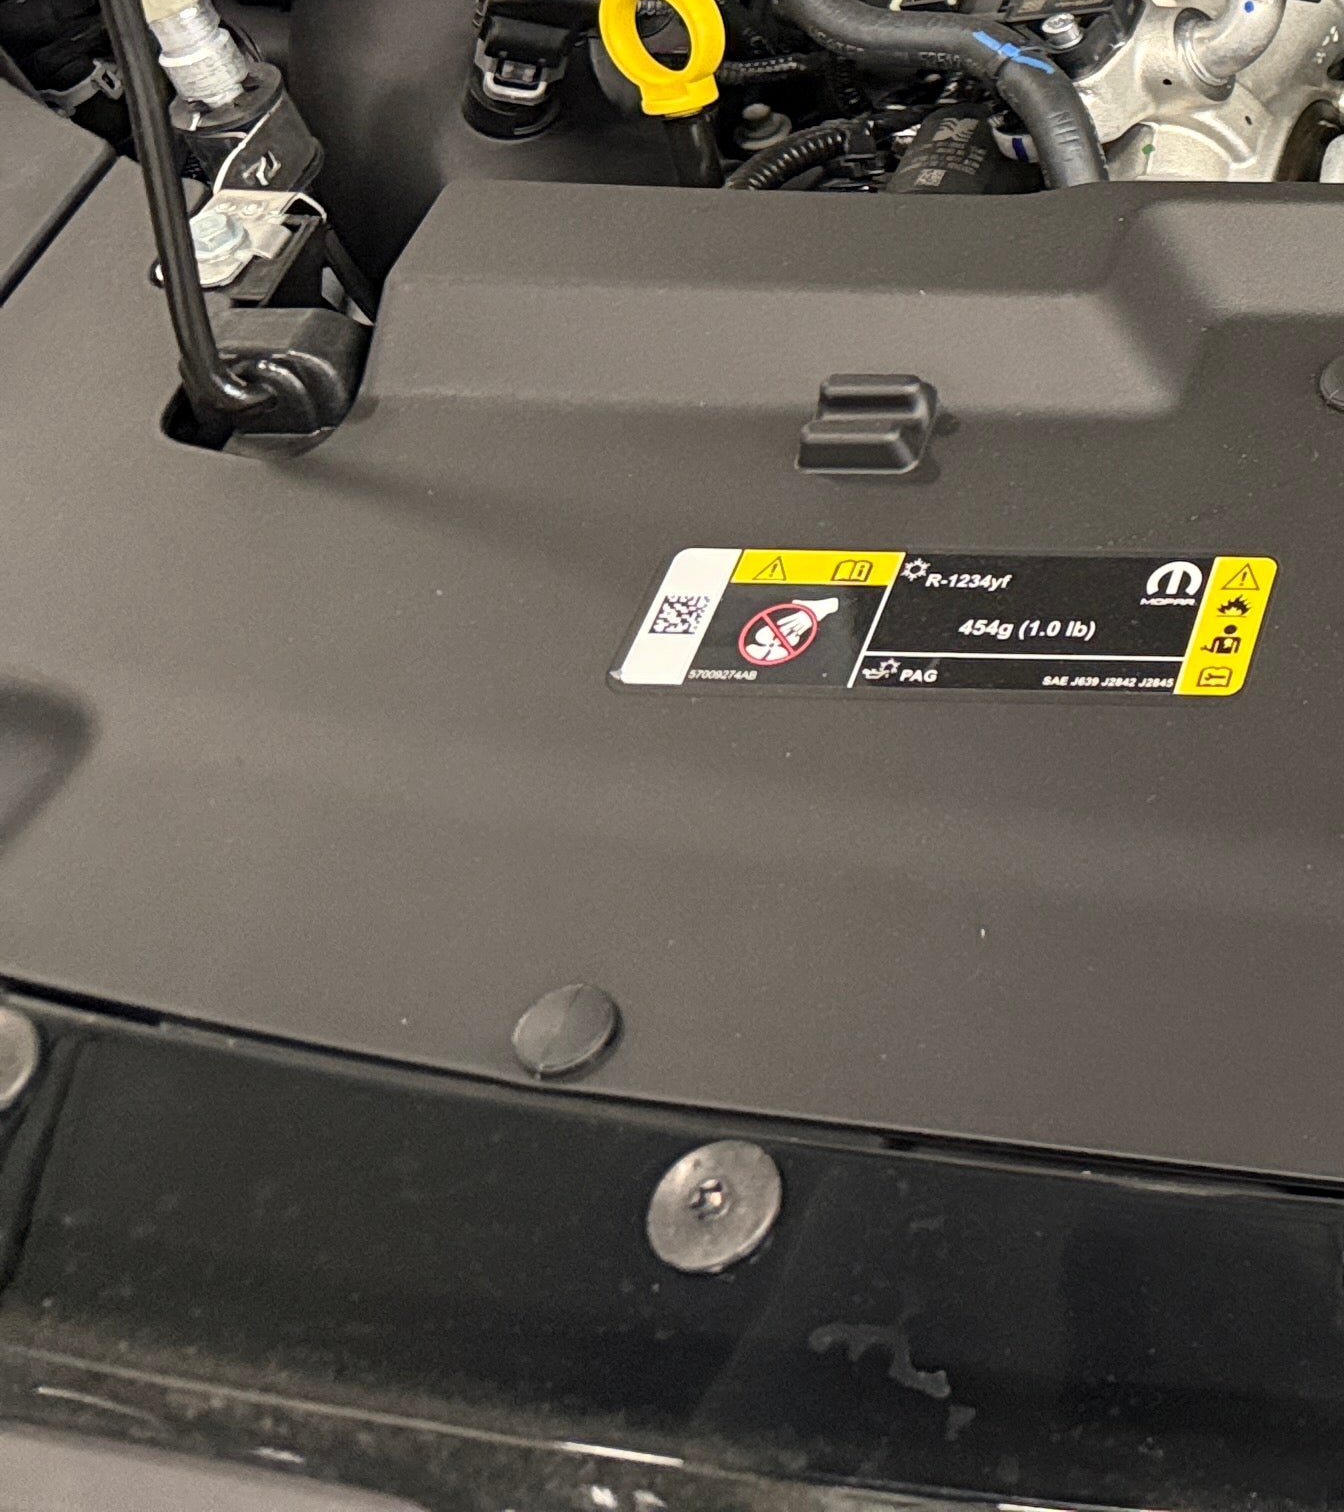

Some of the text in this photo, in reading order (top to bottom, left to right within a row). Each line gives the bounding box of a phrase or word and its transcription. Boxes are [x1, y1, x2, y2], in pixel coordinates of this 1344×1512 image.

[925, 573, 1012, 591] R-1234yf
[1140, 597, 1196, 606] MOPAR
[958, 619, 1096, 641] 454g (1.0 lb)
[900, 669, 1174, 688] PAG SAE J639 J2842 J2845
